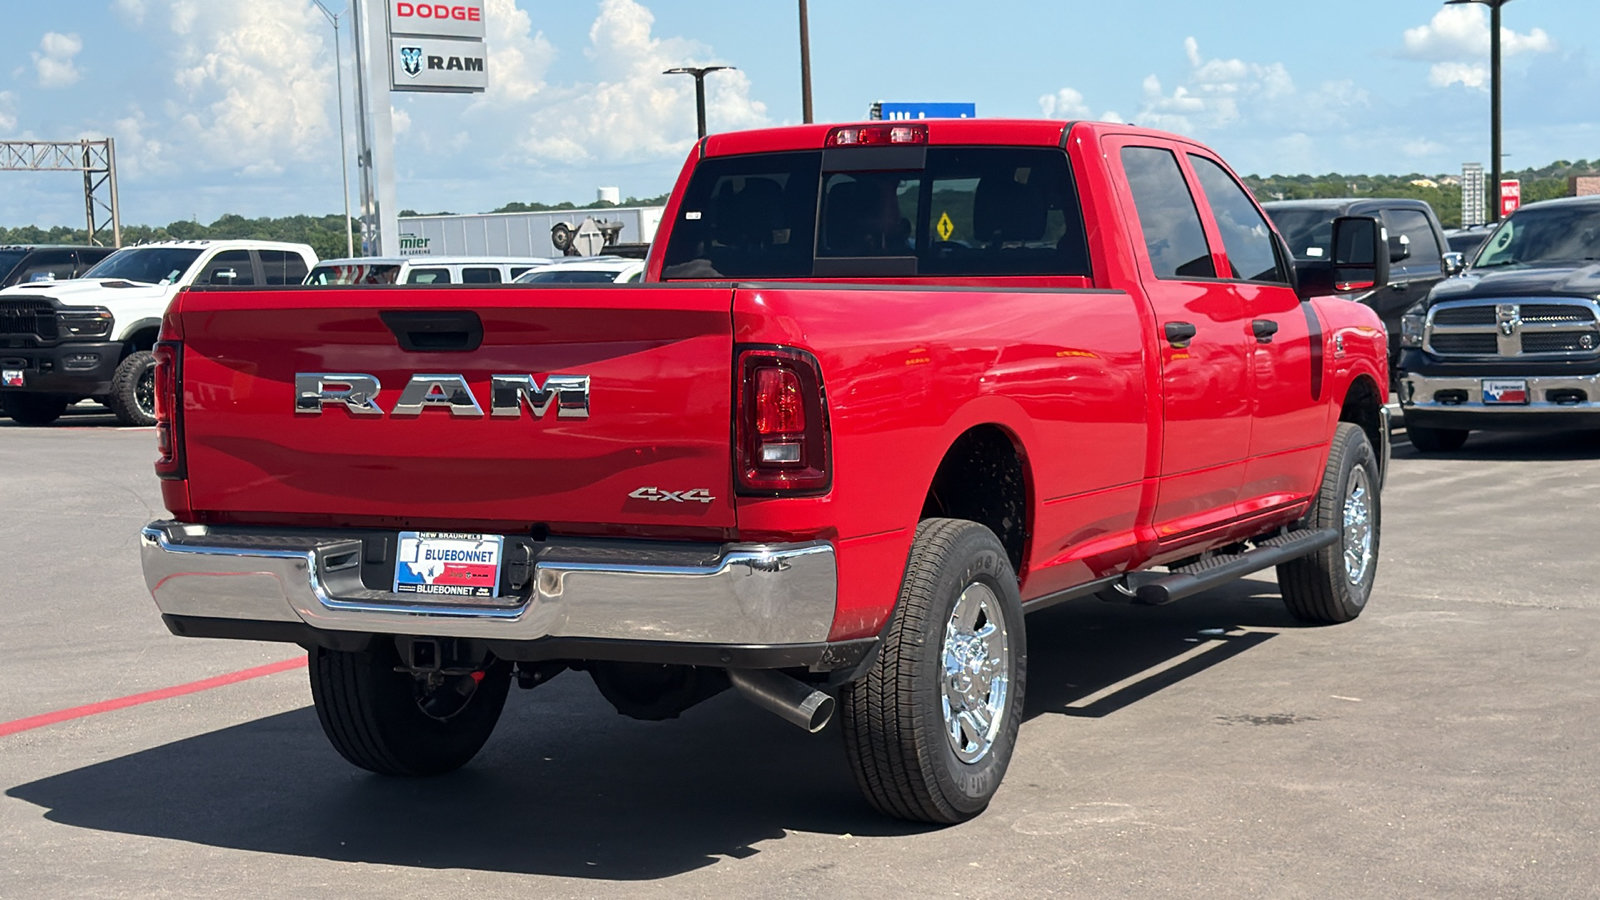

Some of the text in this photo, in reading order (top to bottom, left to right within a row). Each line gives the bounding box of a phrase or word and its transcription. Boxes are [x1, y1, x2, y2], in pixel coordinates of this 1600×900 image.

[397, 2, 480, 22] DODGE
[427, 55, 484, 72] RAM
[400, 238, 430, 248] mier
[295, 372, 590, 418] RAM
[627, 486, 717, 503] 4x4
[438, 532, 481, 540] BRAUNFELS
[425, 549, 494, 563] BLUEBONNET
[416, 585, 474, 595] BLUEBONNET
